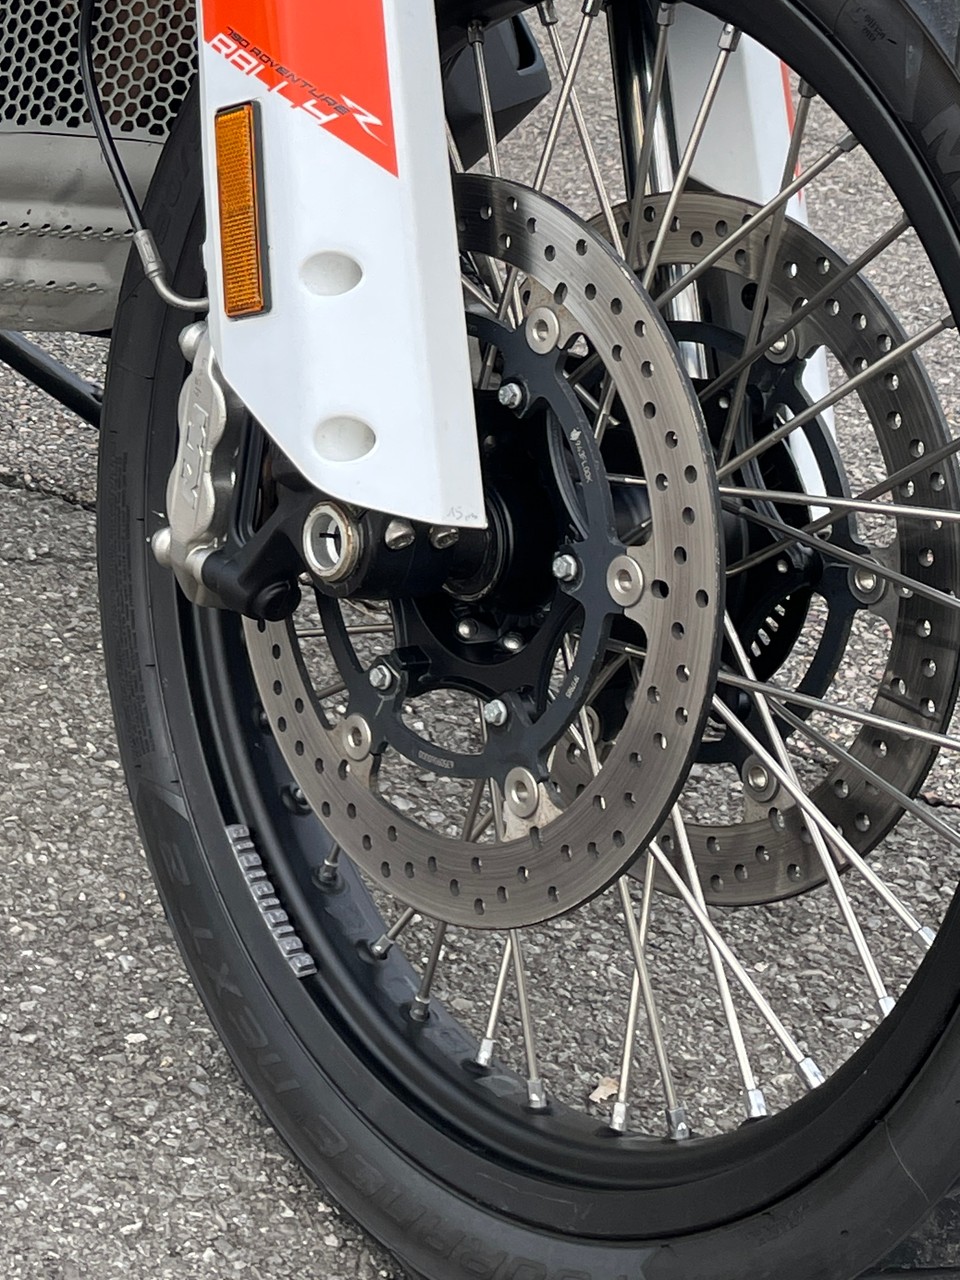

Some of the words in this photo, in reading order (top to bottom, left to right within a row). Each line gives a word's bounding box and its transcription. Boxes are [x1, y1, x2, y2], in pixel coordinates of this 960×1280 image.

[208, 31, 340, 126] RALLY
[226, 25, 250, 49] 790
[250, 46, 351, 116] ADVENTURE
